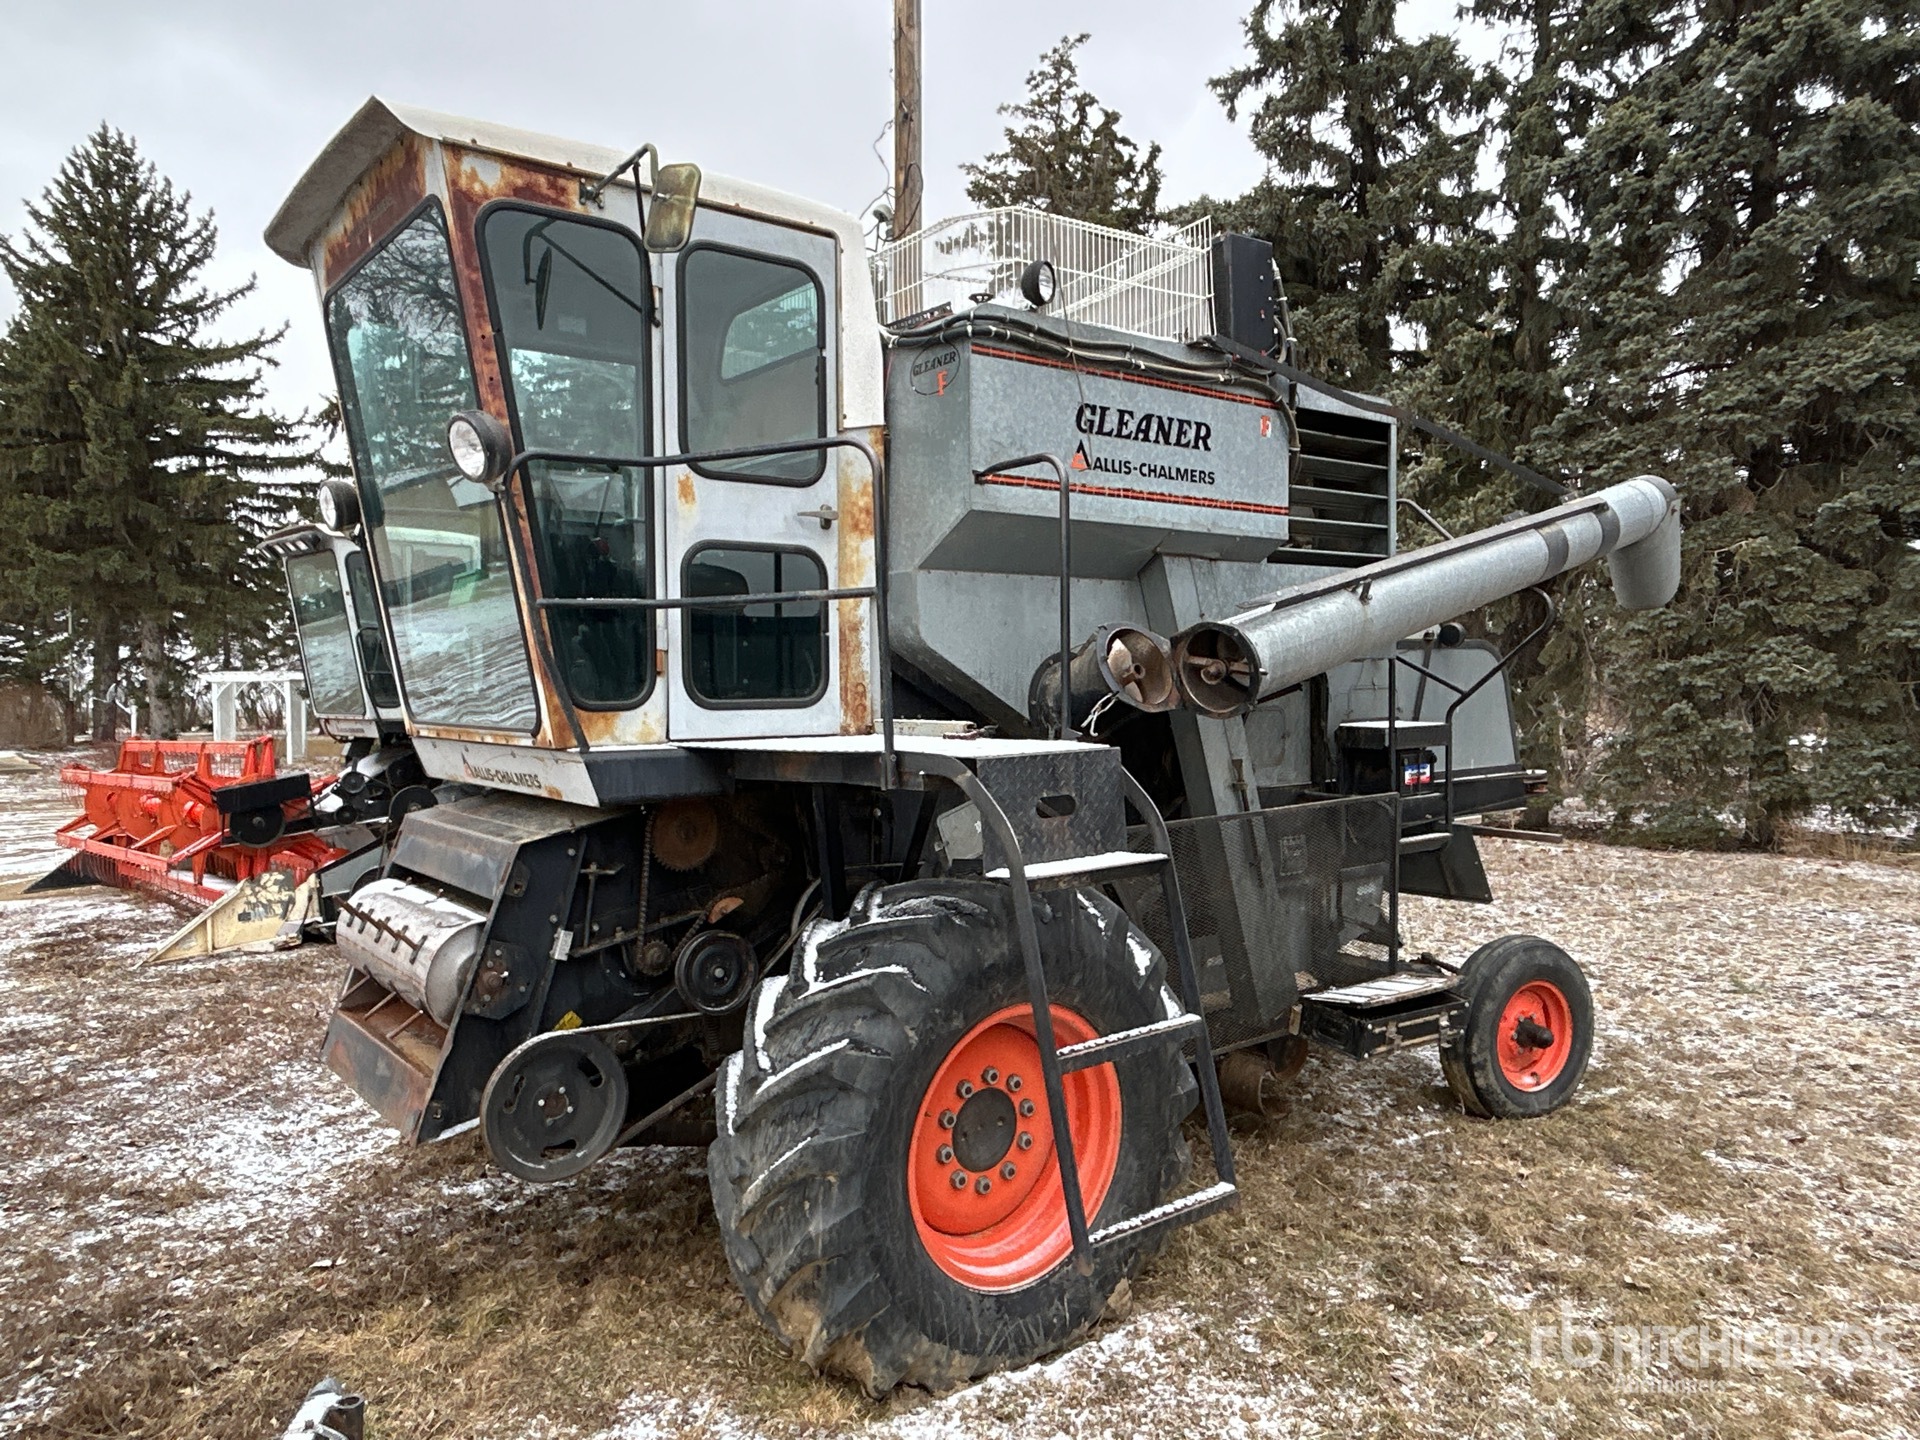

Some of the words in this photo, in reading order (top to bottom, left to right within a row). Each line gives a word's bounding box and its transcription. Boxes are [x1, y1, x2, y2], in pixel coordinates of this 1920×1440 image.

[912, 350, 957, 377] GLEANER
[1075, 402, 1212, 452] GLEANER
[1092, 456, 1216, 485] ALLIS-CHALMERS
